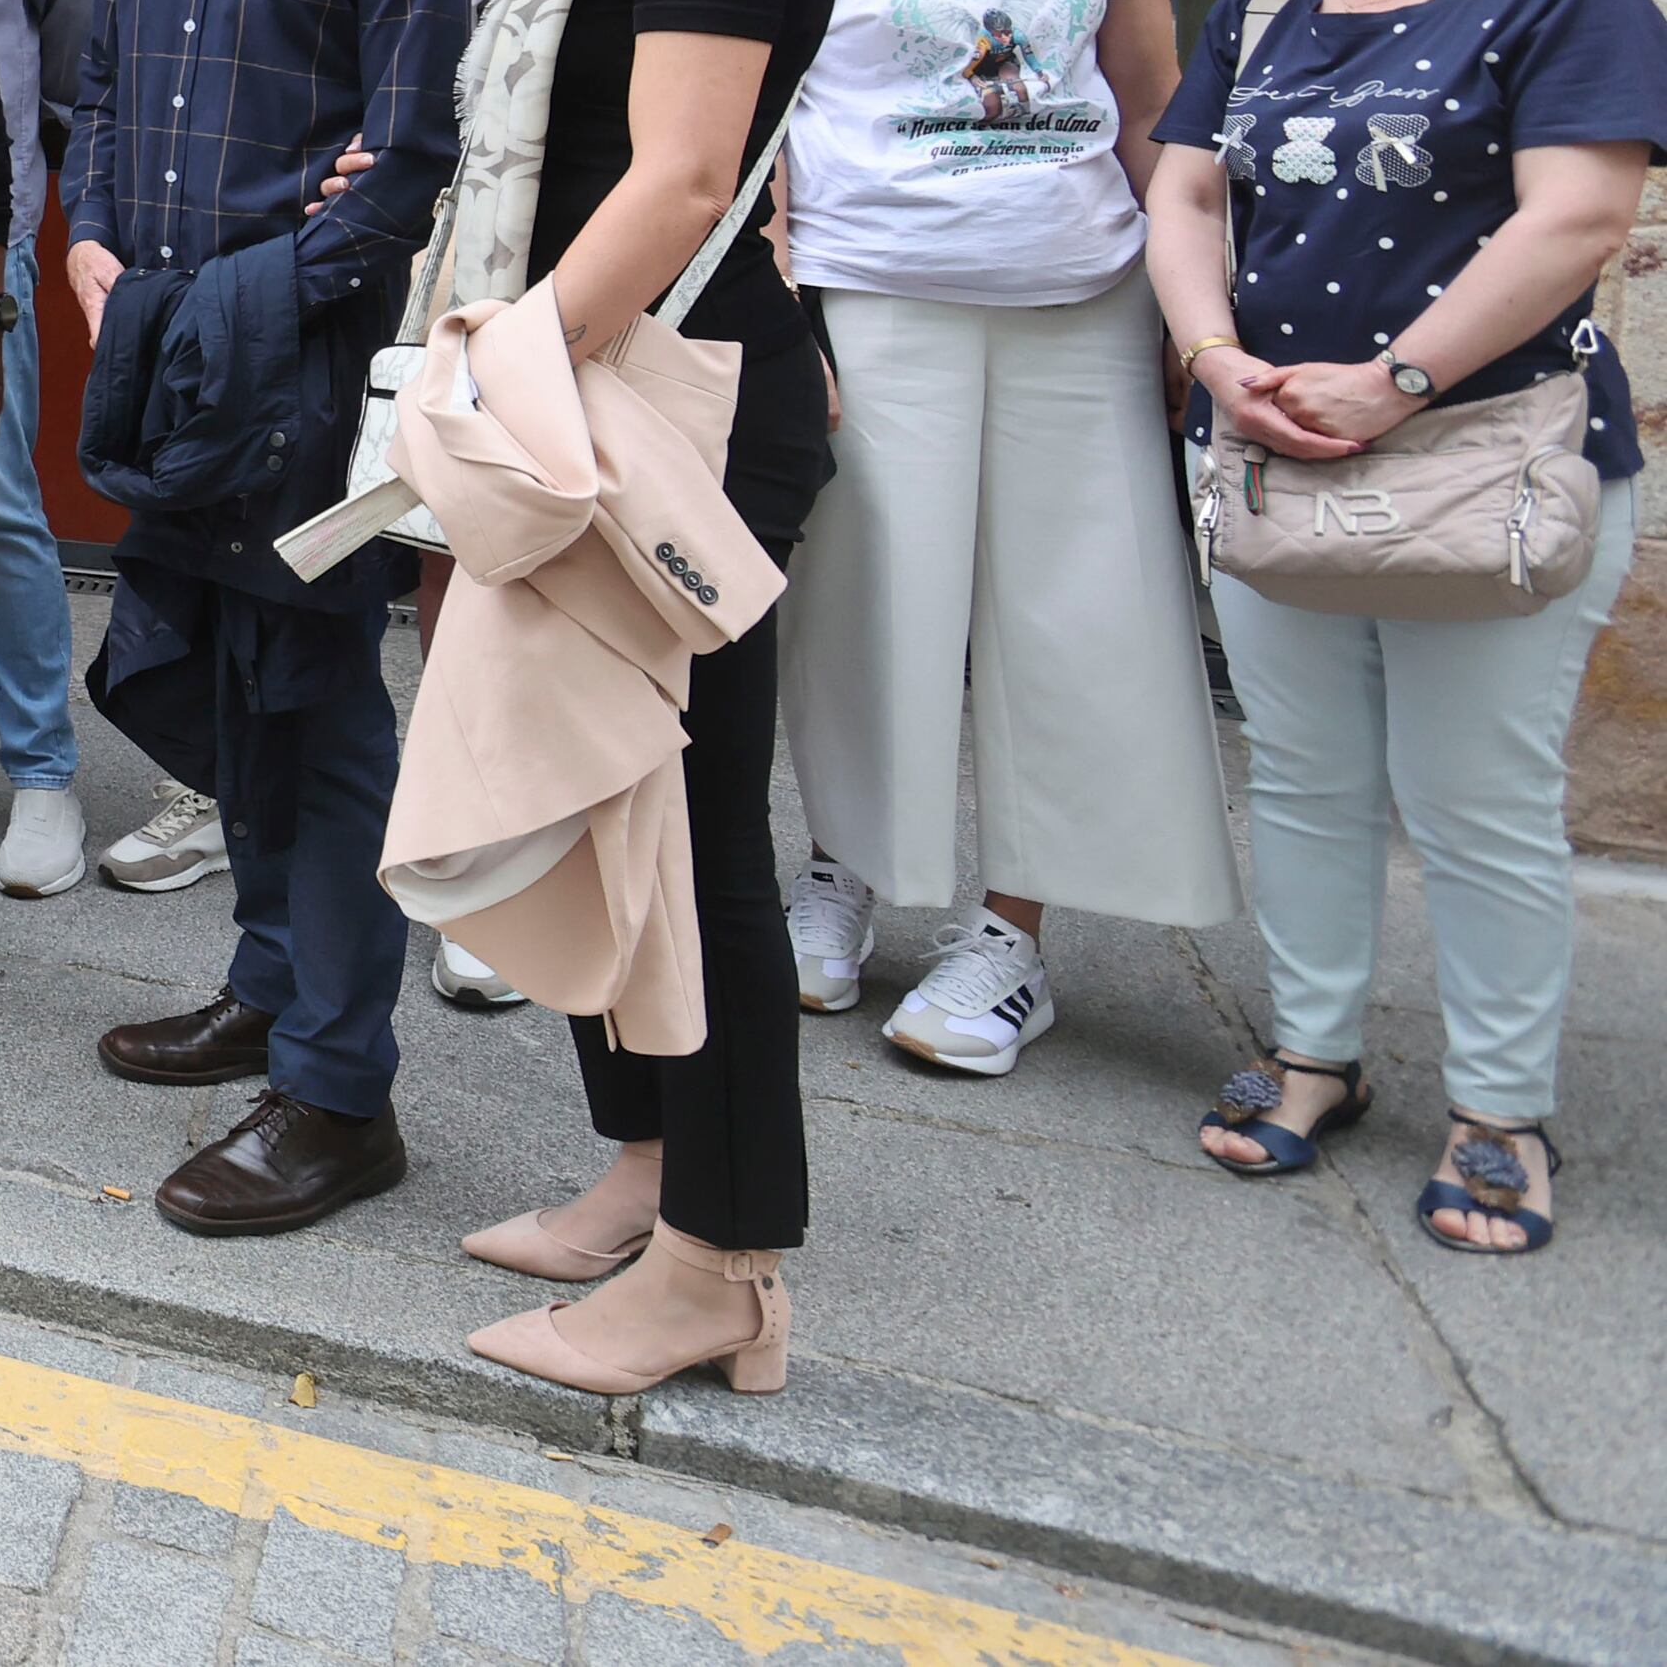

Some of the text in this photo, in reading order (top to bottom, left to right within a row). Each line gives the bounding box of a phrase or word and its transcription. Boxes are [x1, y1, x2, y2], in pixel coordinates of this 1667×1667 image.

[910, 119, 967, 140] Nunca
[1026, 112, 1051, 131] del
[1055, 113, 1101, 132] alma
[931, 142, 983, 159] quienes
[1040, 142, 1084, 155] magia
